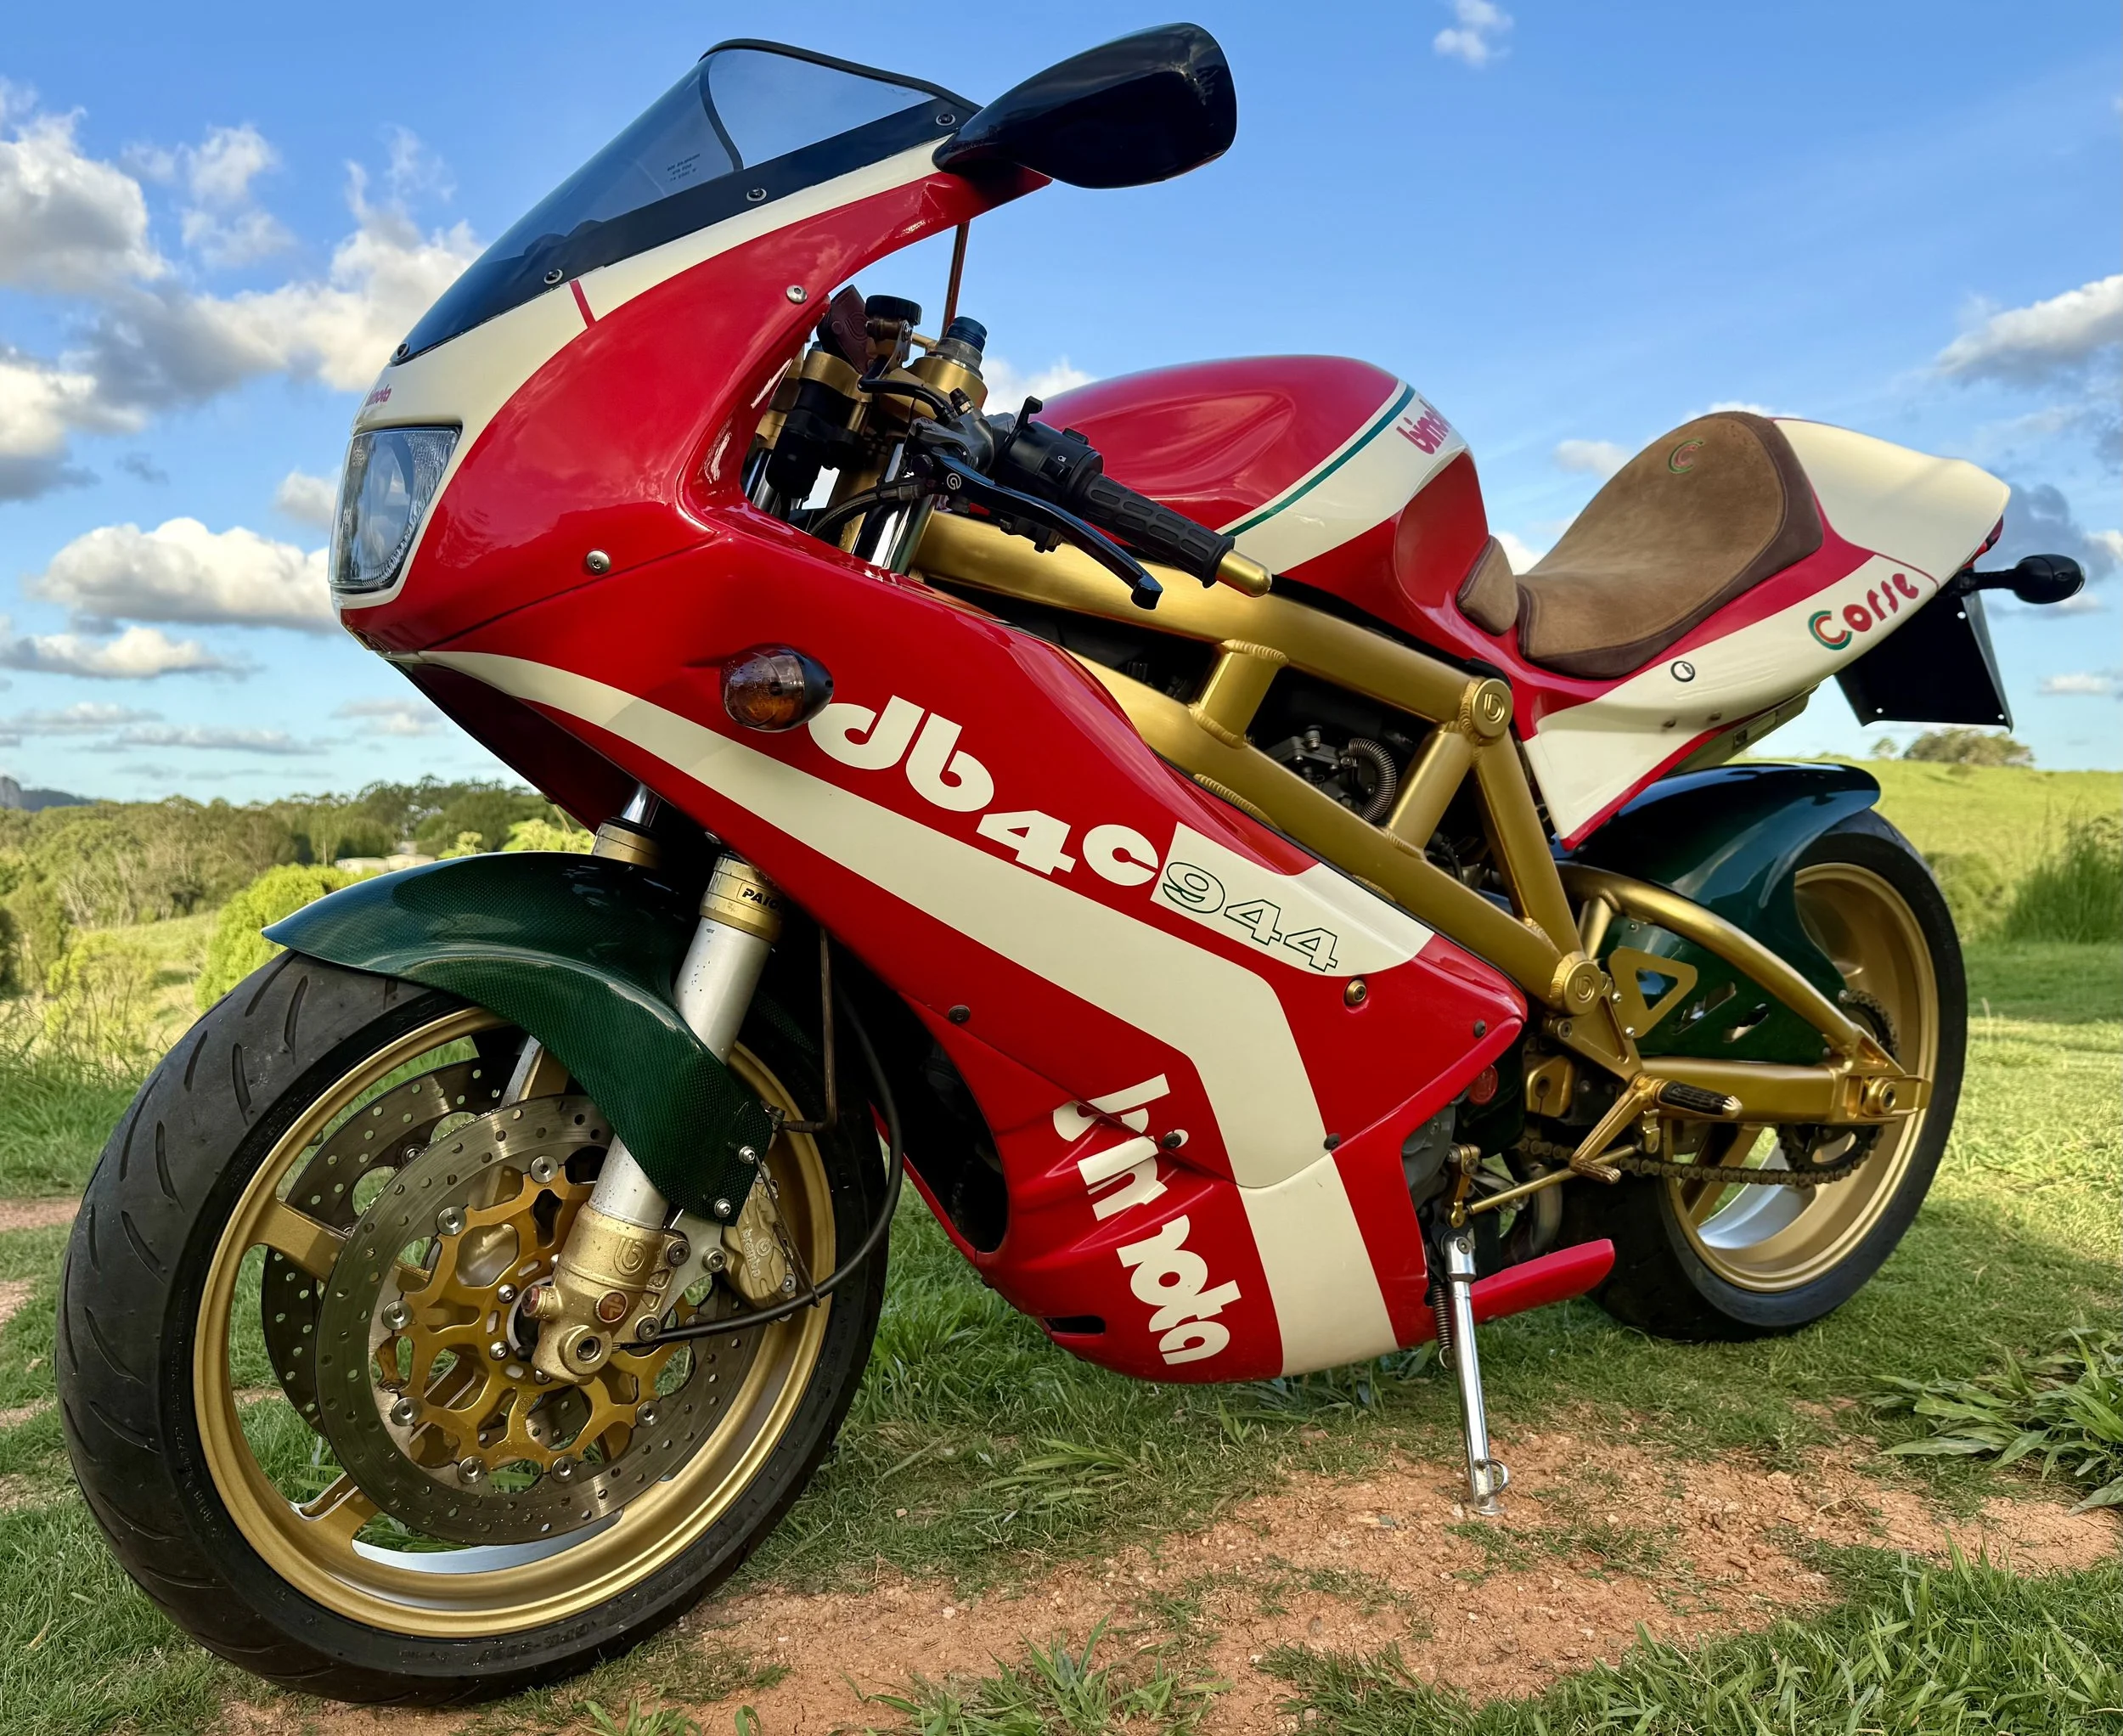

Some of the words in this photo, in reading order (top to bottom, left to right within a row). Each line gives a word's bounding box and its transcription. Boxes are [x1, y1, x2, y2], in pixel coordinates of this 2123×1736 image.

[1808, 573, 1919, 651] Corse
[741, 888, 781, 915] PAIO
[1162, 860, 1338, 972] 944
[1053, 1073, 1242, 1365] bimota
